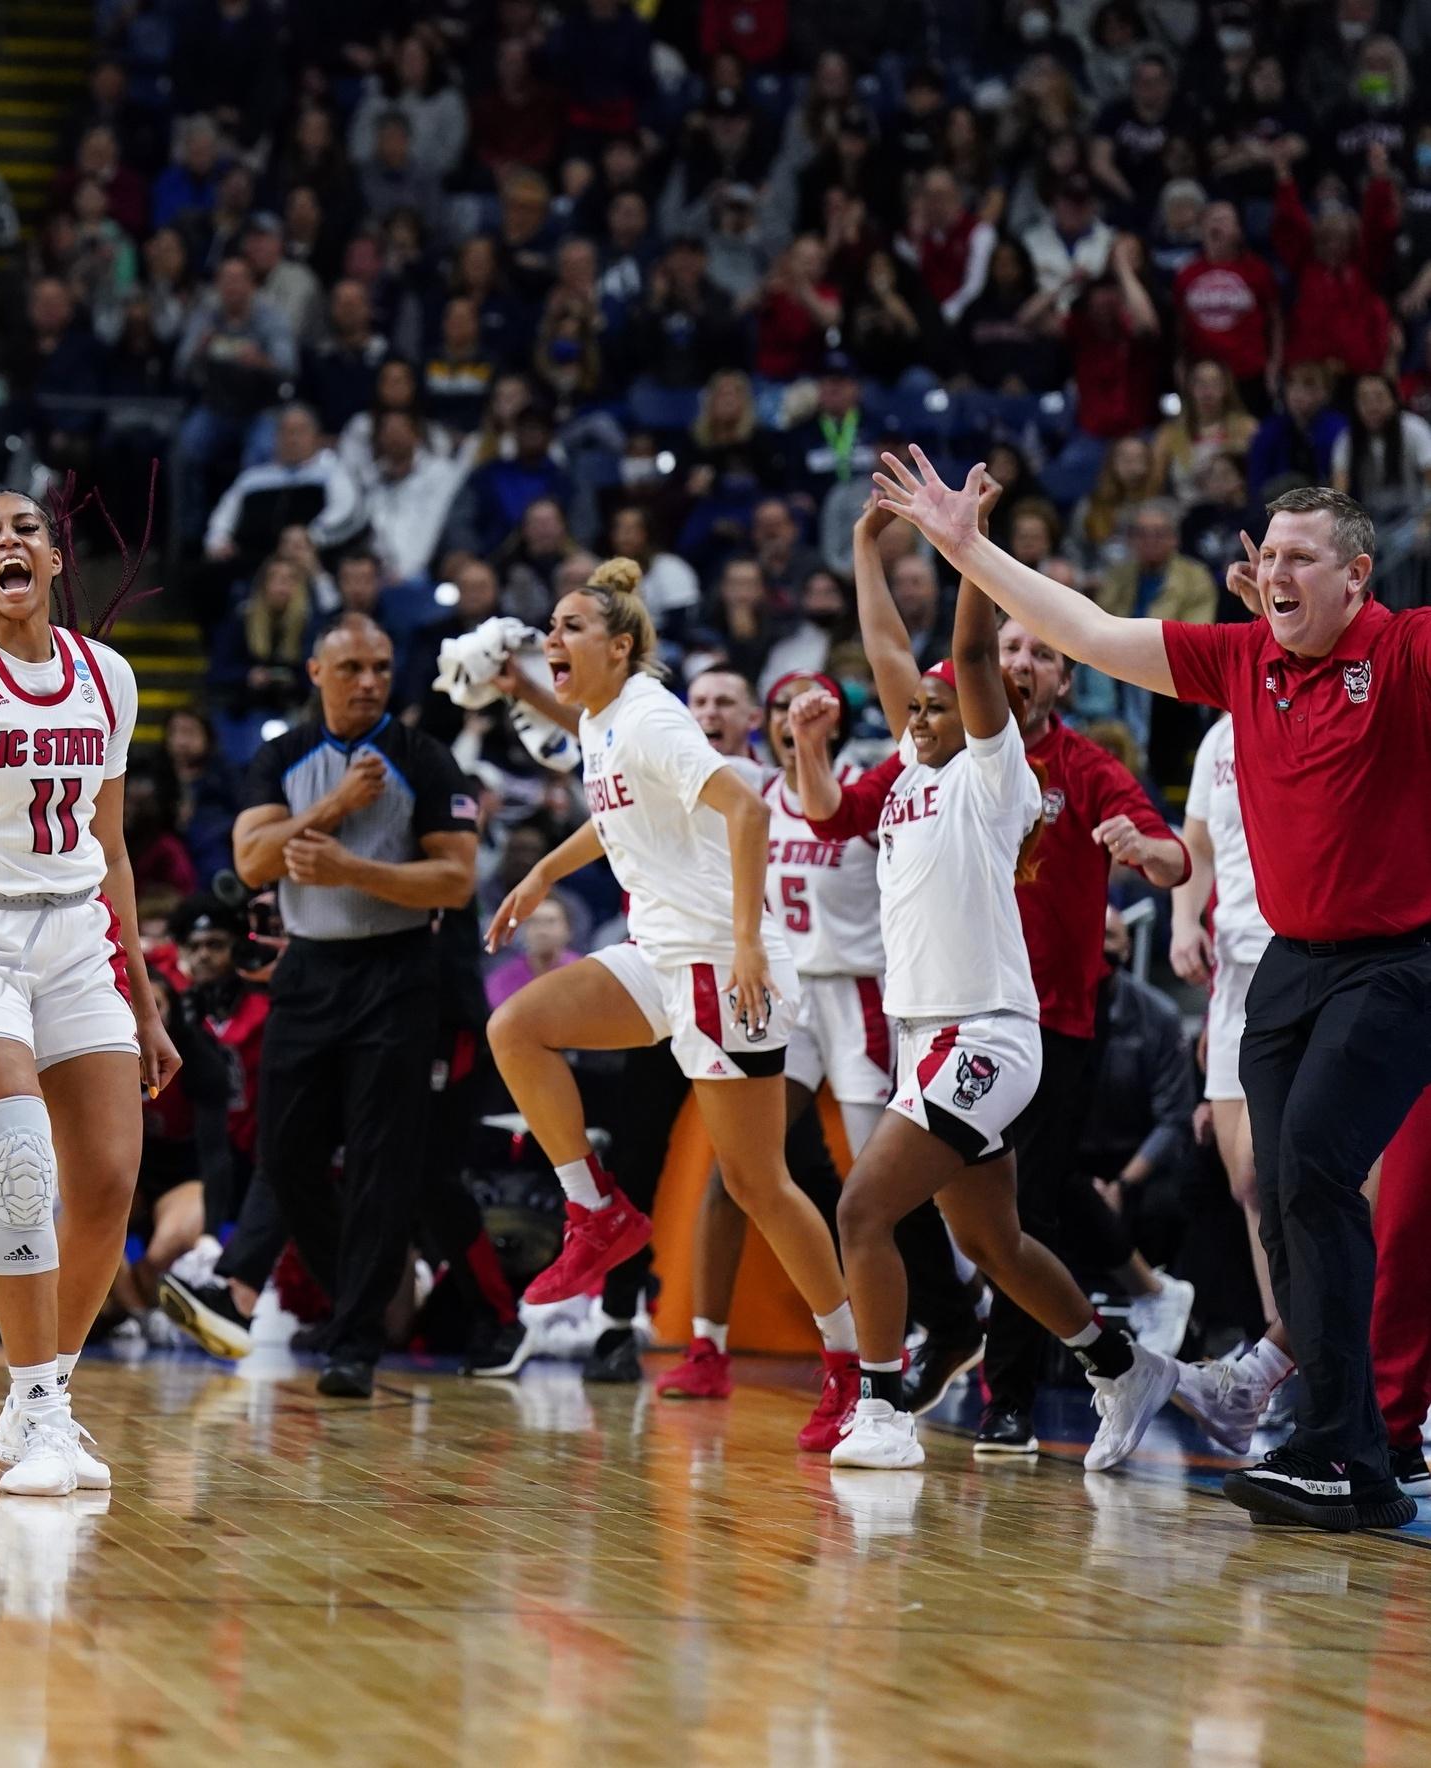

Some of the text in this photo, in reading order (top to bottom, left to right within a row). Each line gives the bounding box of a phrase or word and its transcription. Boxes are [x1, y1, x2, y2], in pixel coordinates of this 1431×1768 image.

[33, 728, 104, 766] STATE
[29, 778, 82, 855] 11
[781, 840, 846, 868] STATE
[781, 876, 811, 932] 5
